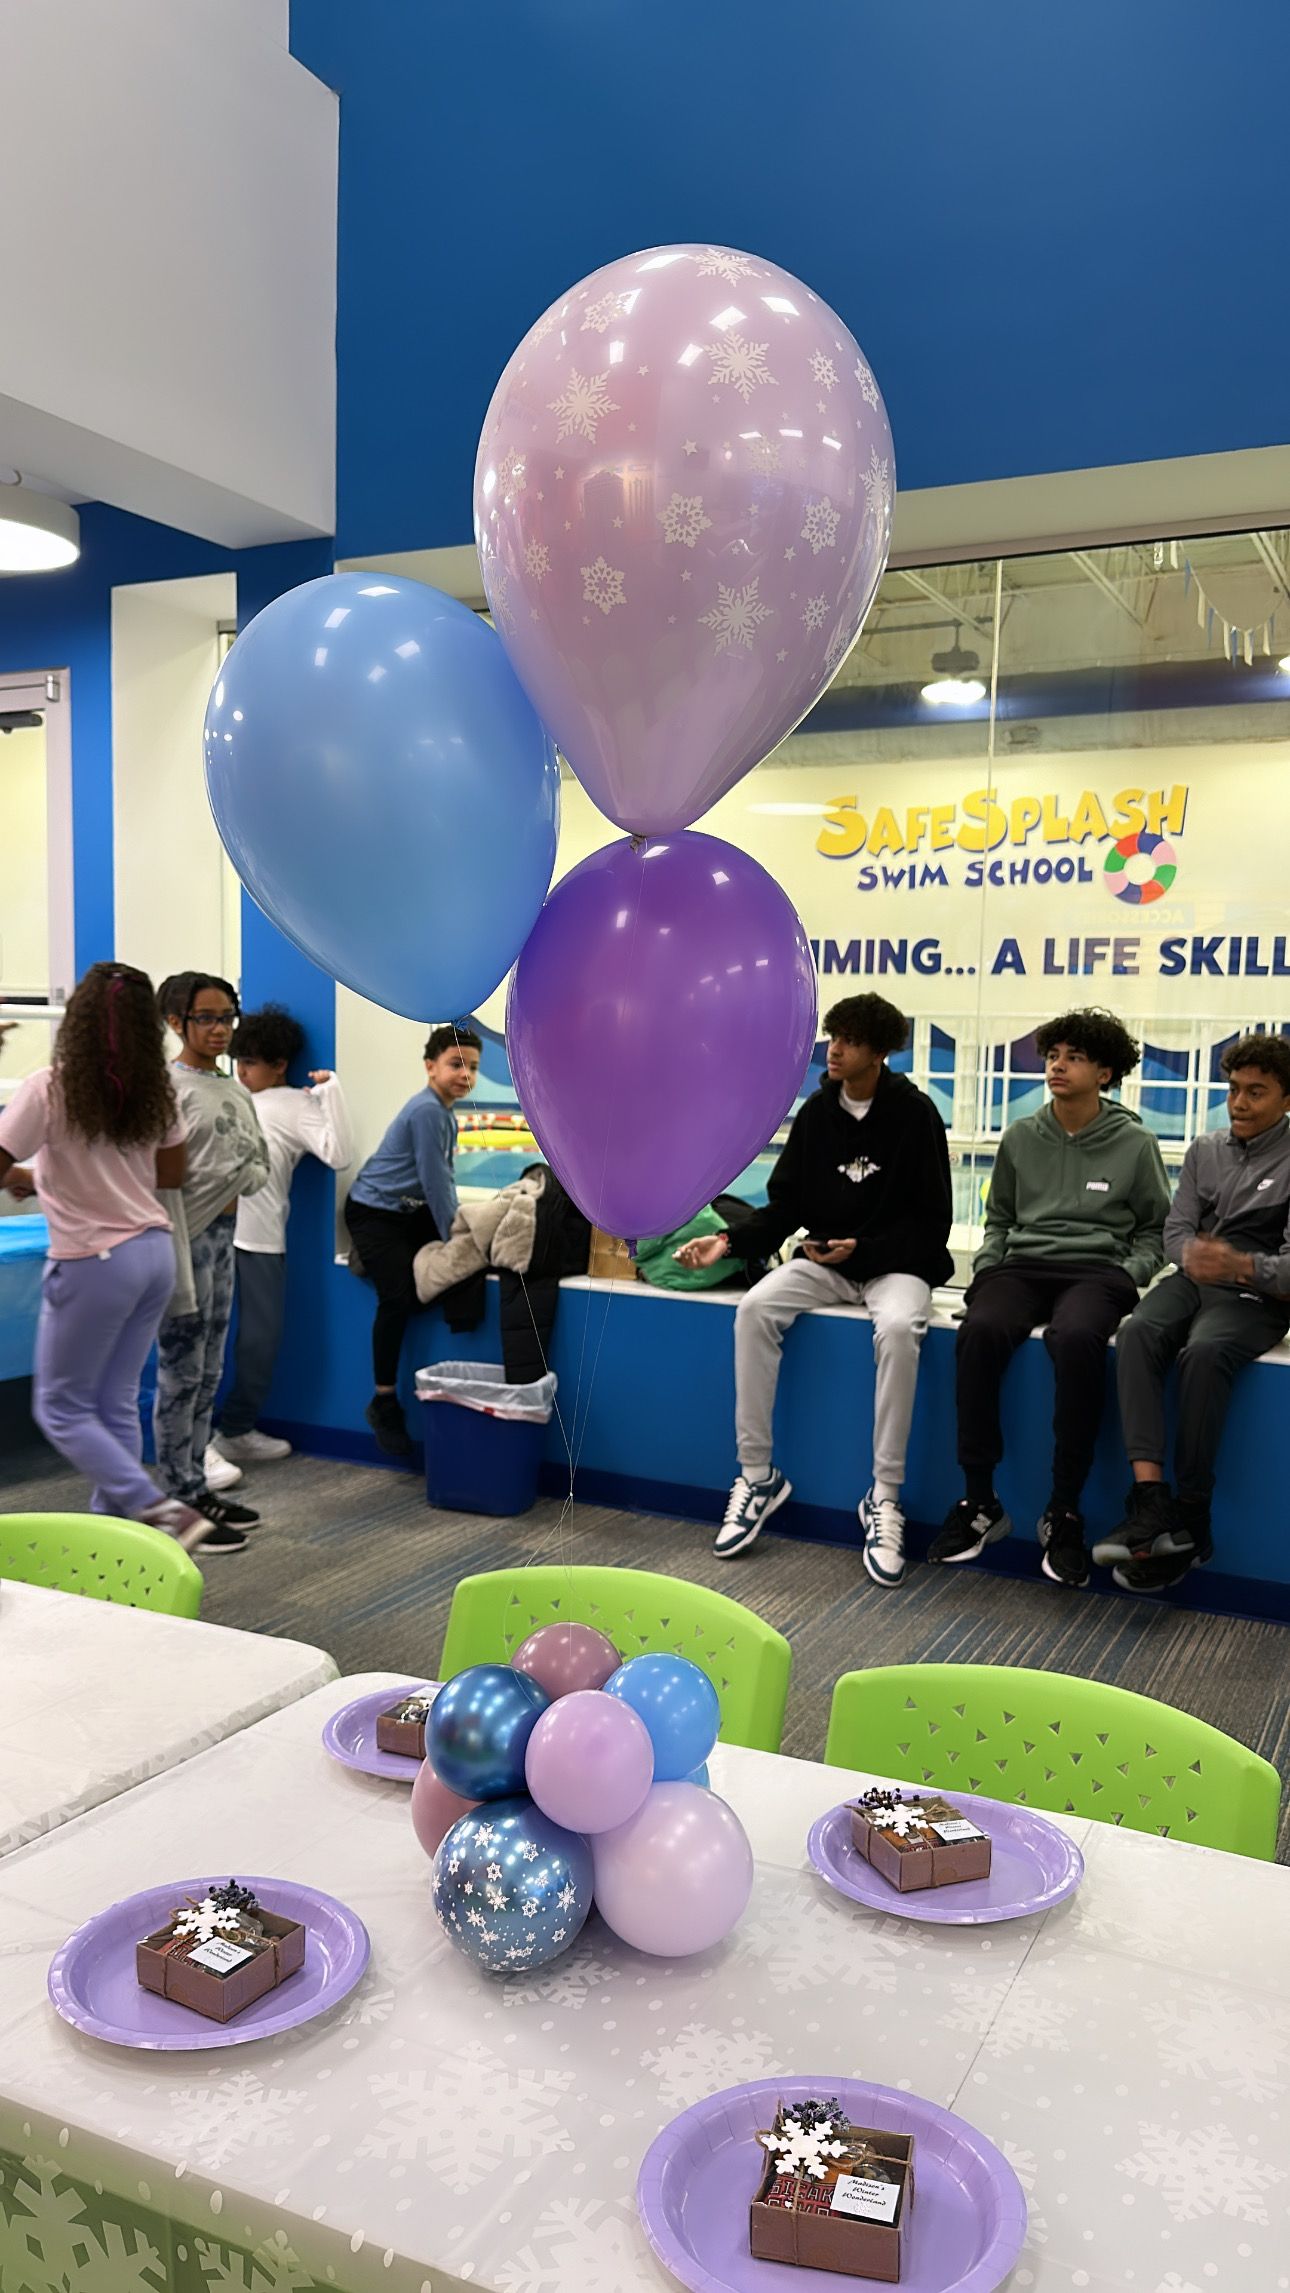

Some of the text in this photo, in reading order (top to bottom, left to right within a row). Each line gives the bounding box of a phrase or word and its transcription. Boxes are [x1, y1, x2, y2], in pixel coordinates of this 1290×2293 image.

[857, 856, 1093, 891] SWIM SCHOOL
[991, 938, 1026, 975] A
[1044, 937, 1140, 975] LIFE
[842, 2192, 887, 2206] Wonderland
